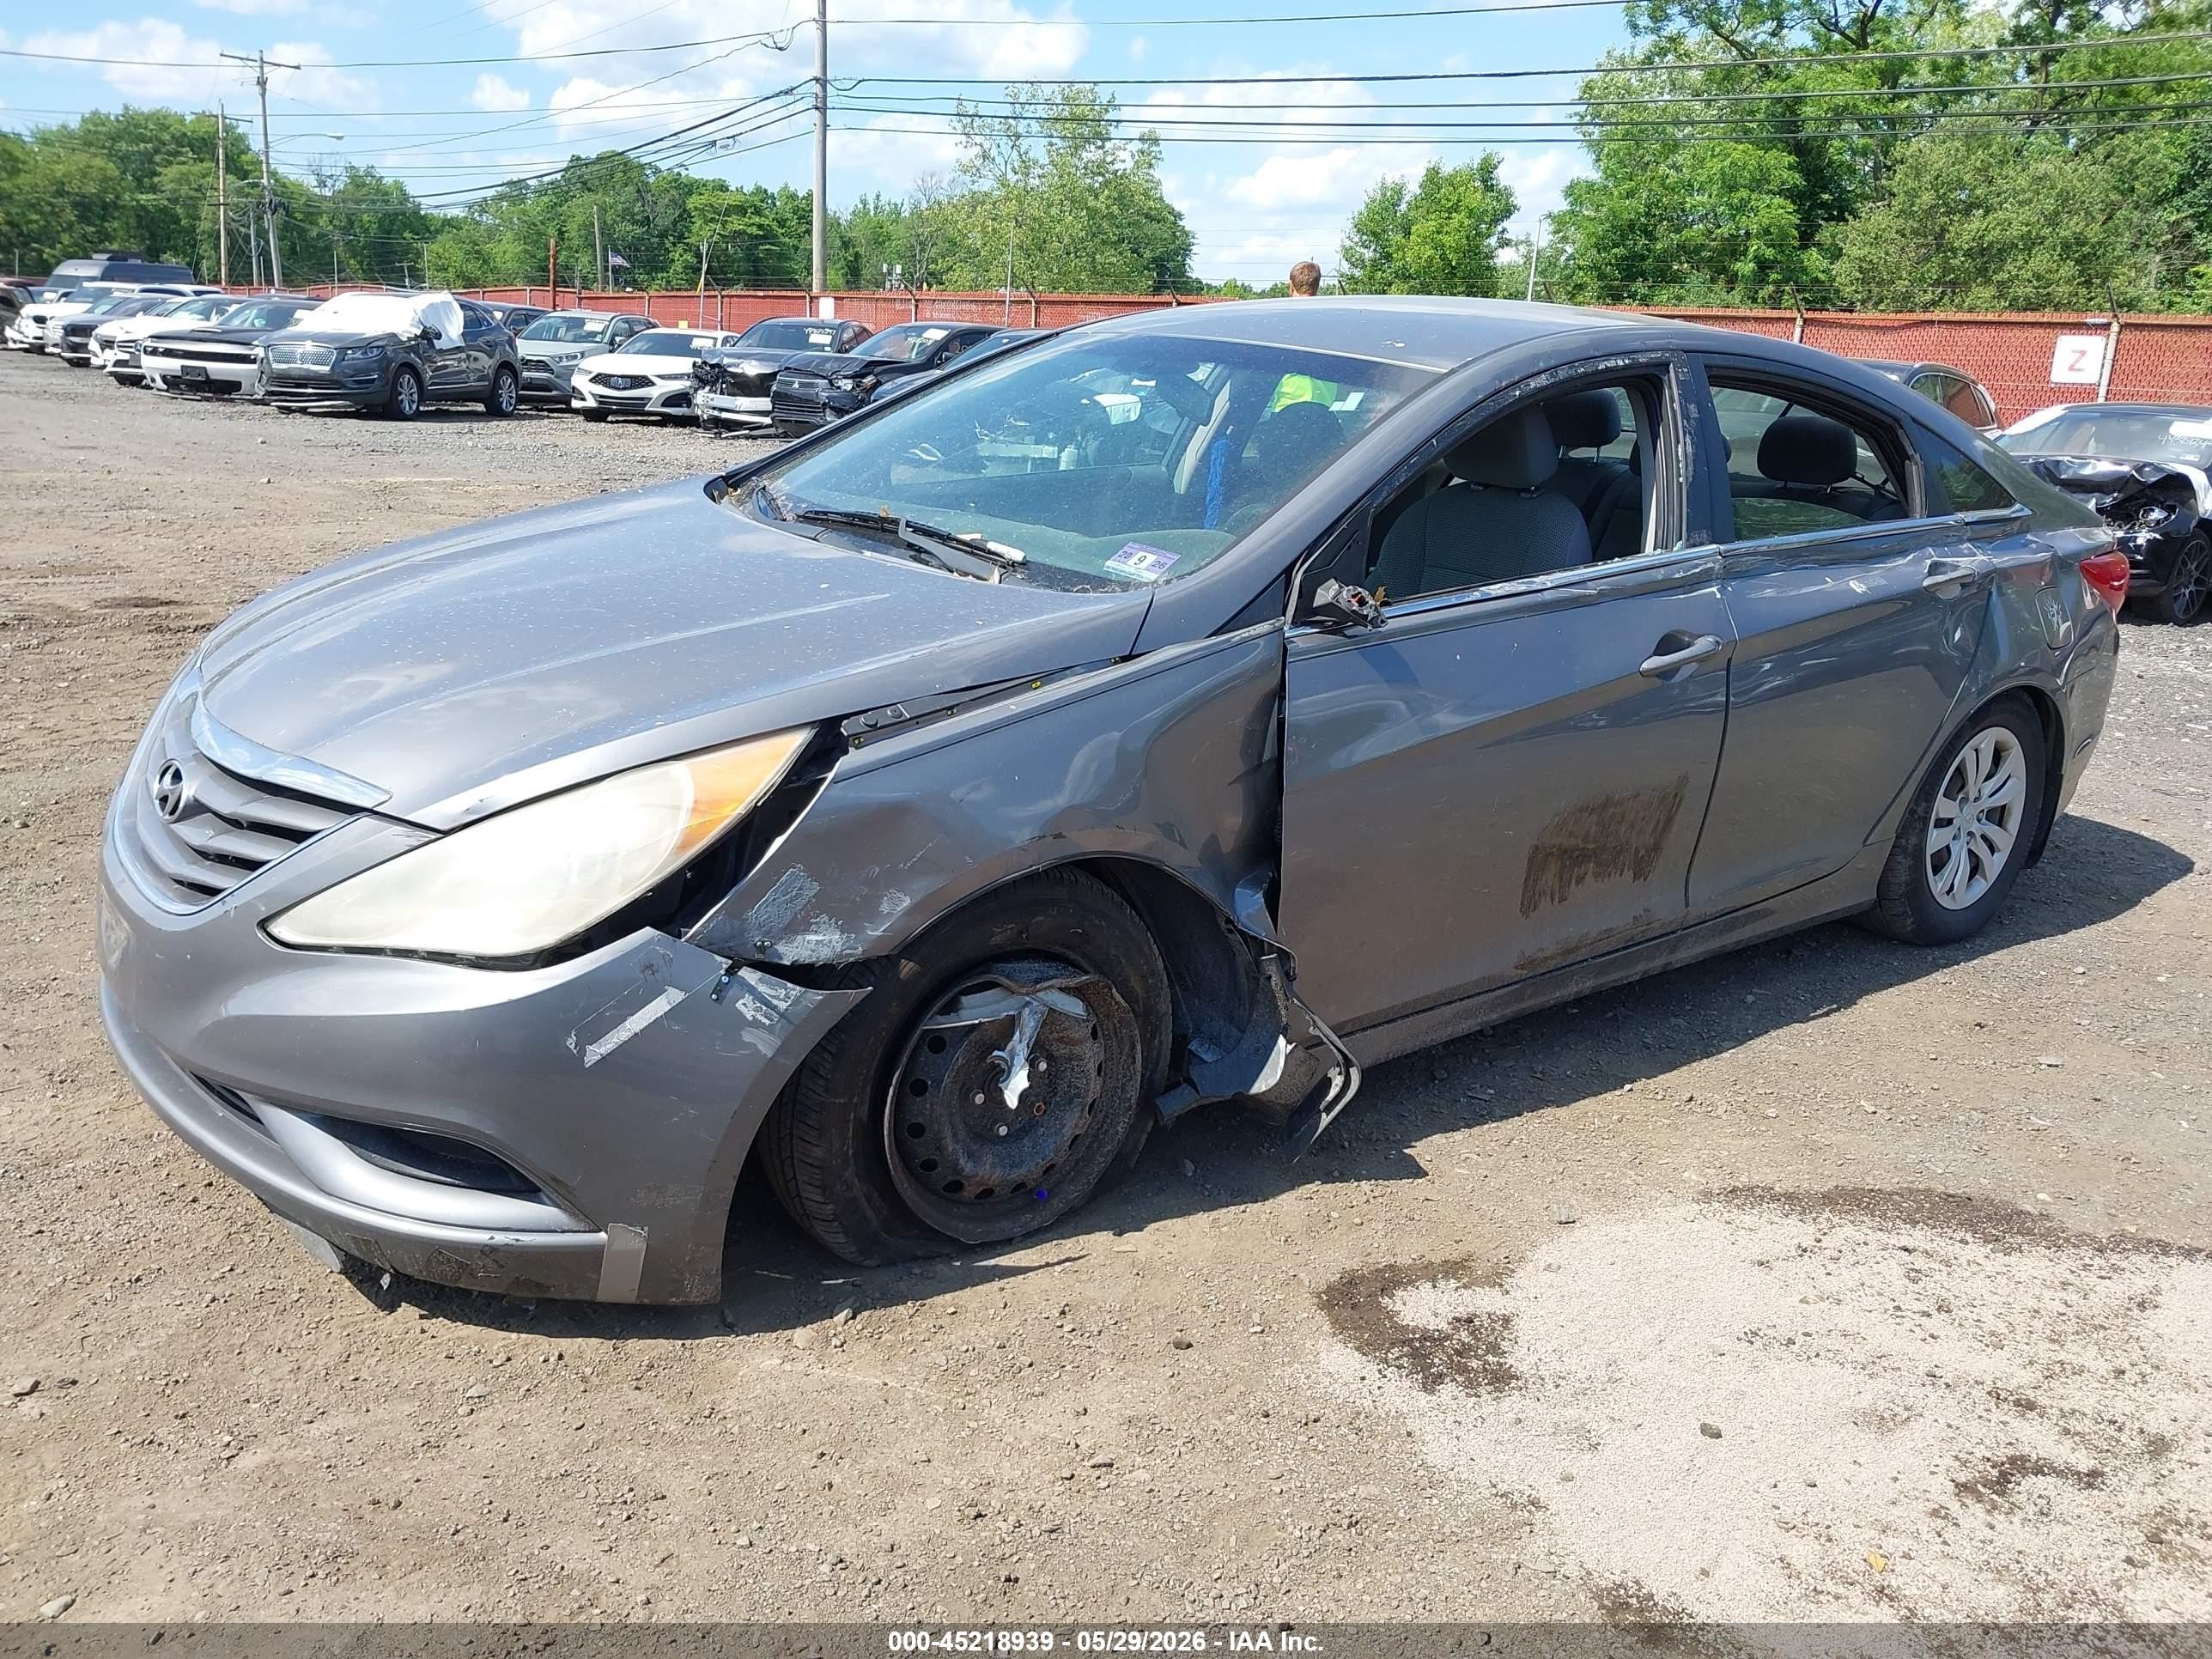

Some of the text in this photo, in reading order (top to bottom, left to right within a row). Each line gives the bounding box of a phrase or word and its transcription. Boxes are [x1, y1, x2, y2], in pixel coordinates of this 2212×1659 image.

[2067, 349, 2089, 372] Z
[1133, 555, 1147, 566] 9
[1152, 561, 1167, 569] 26
